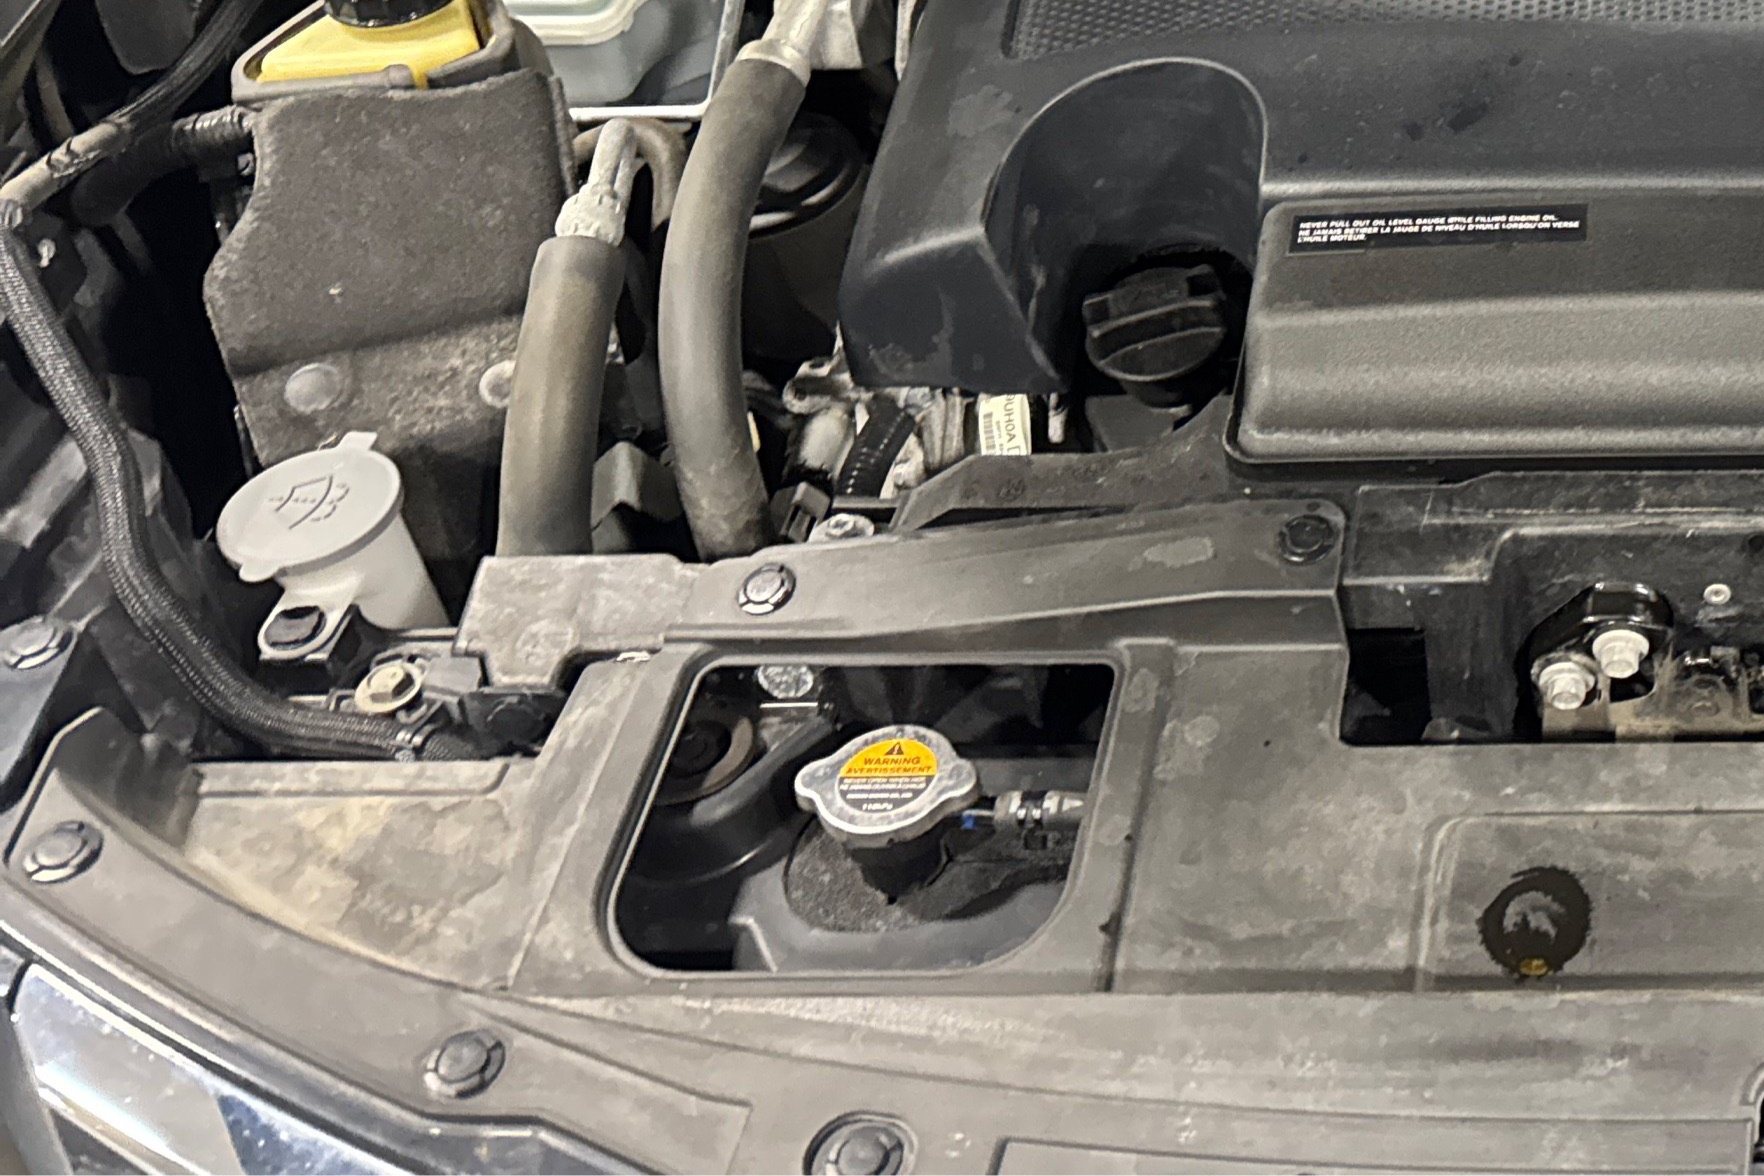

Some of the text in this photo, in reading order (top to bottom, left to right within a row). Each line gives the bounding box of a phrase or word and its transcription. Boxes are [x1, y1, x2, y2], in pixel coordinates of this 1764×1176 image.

[1330, 220, 1350, 228] PULL
[1388, 218, 1413, 226] LEVEL
[1416, 217, 1446, 225] GAUGE
[1447, 216, 1474, 224] WHILE
[1475, 215, 1506, 223] FILLING
[864, 757, 921, 765] WARNING
